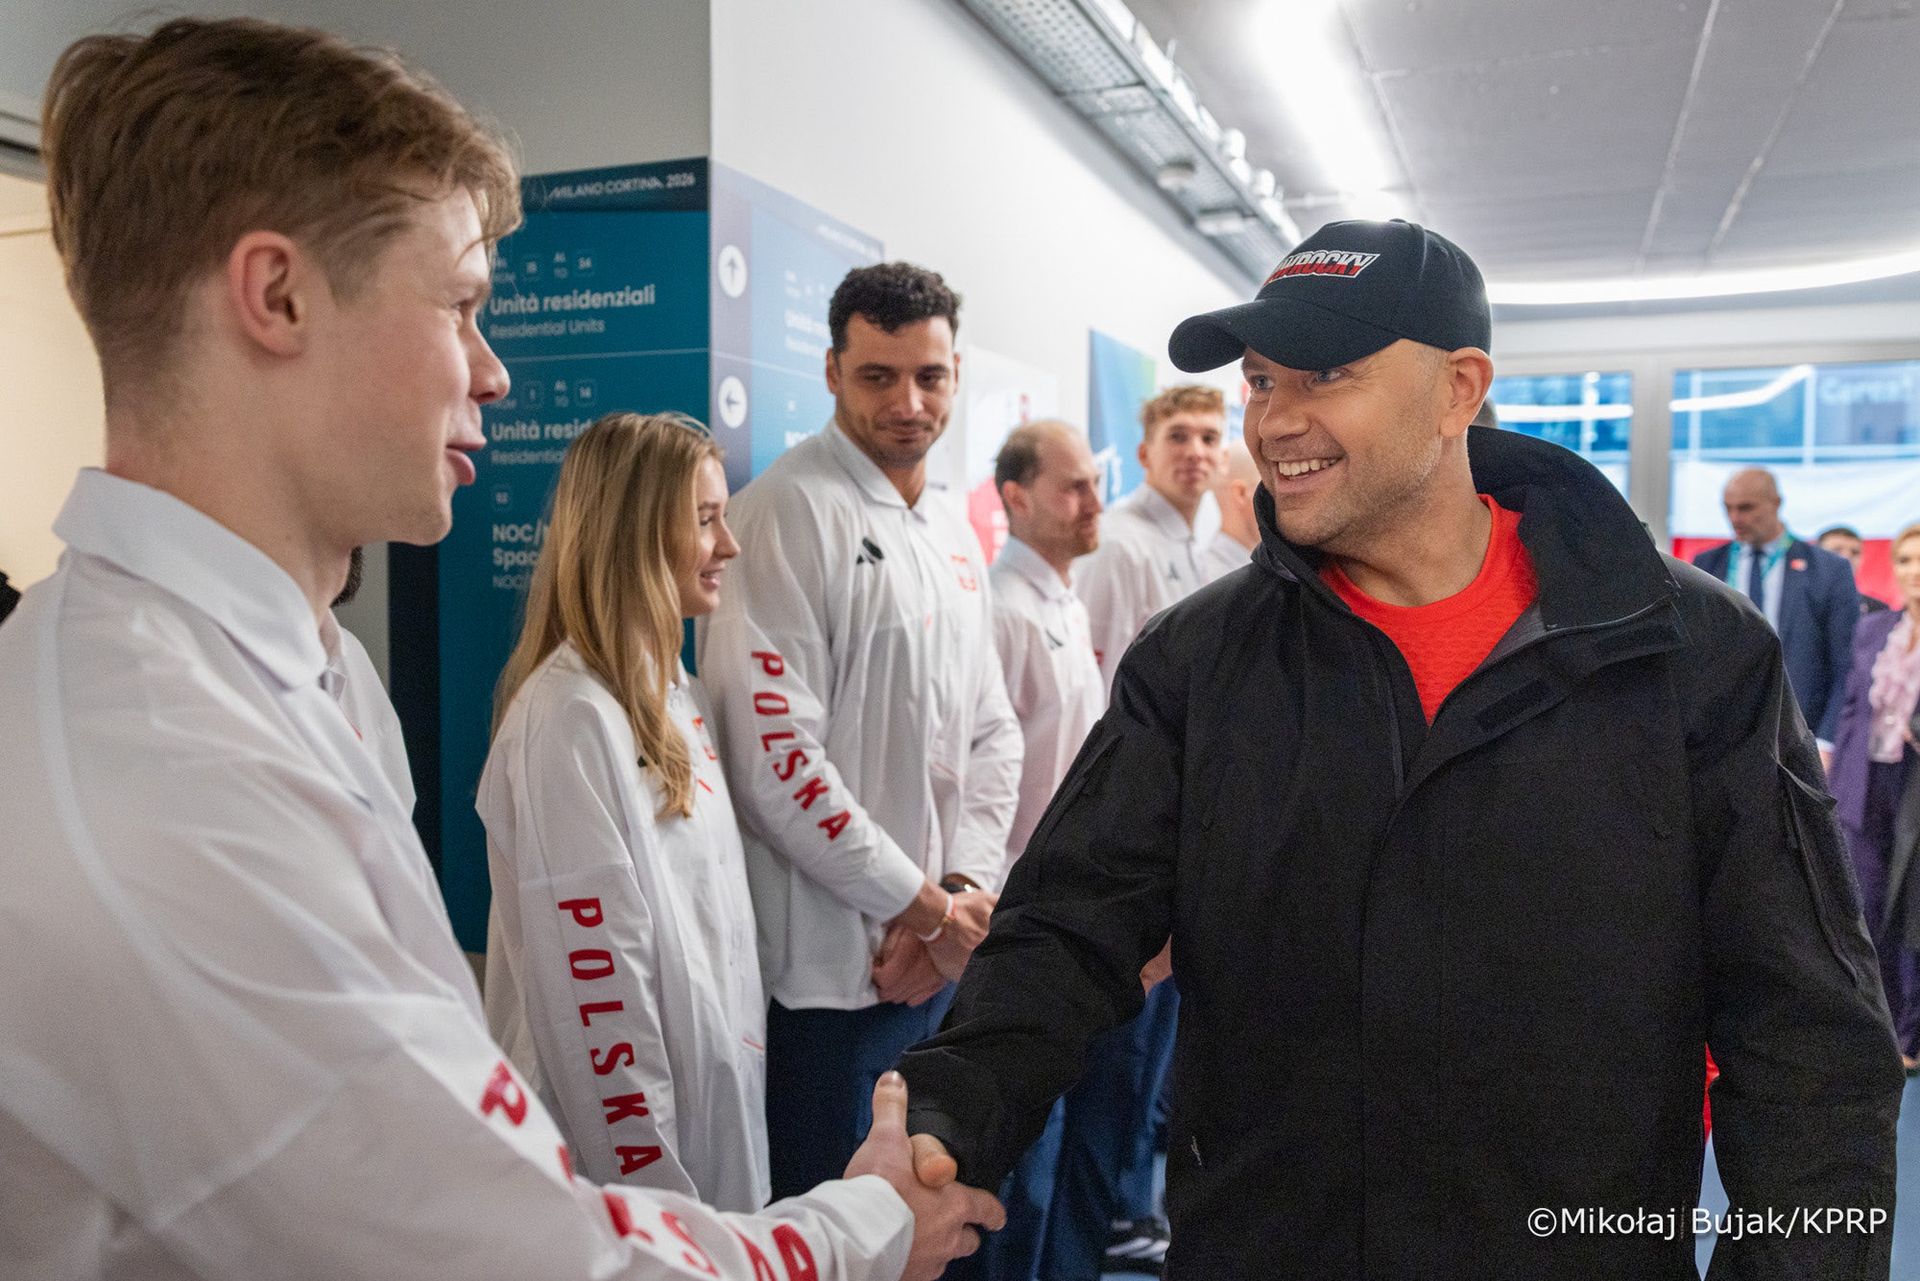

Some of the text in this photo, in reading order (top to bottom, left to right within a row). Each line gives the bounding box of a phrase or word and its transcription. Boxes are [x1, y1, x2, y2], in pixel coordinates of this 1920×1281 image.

[607, 176, 664, 193] CORTINA
[666, 172, 696, 188] 2026
[490, 283, 656, 315] Unità residenziali
[490, 318, 605, 338] Residential Units
[491, 420, 540, 441] Unità
[751, 650, 851, 841] POLSKA
[558, 897, 663, 1176] POLSKA
